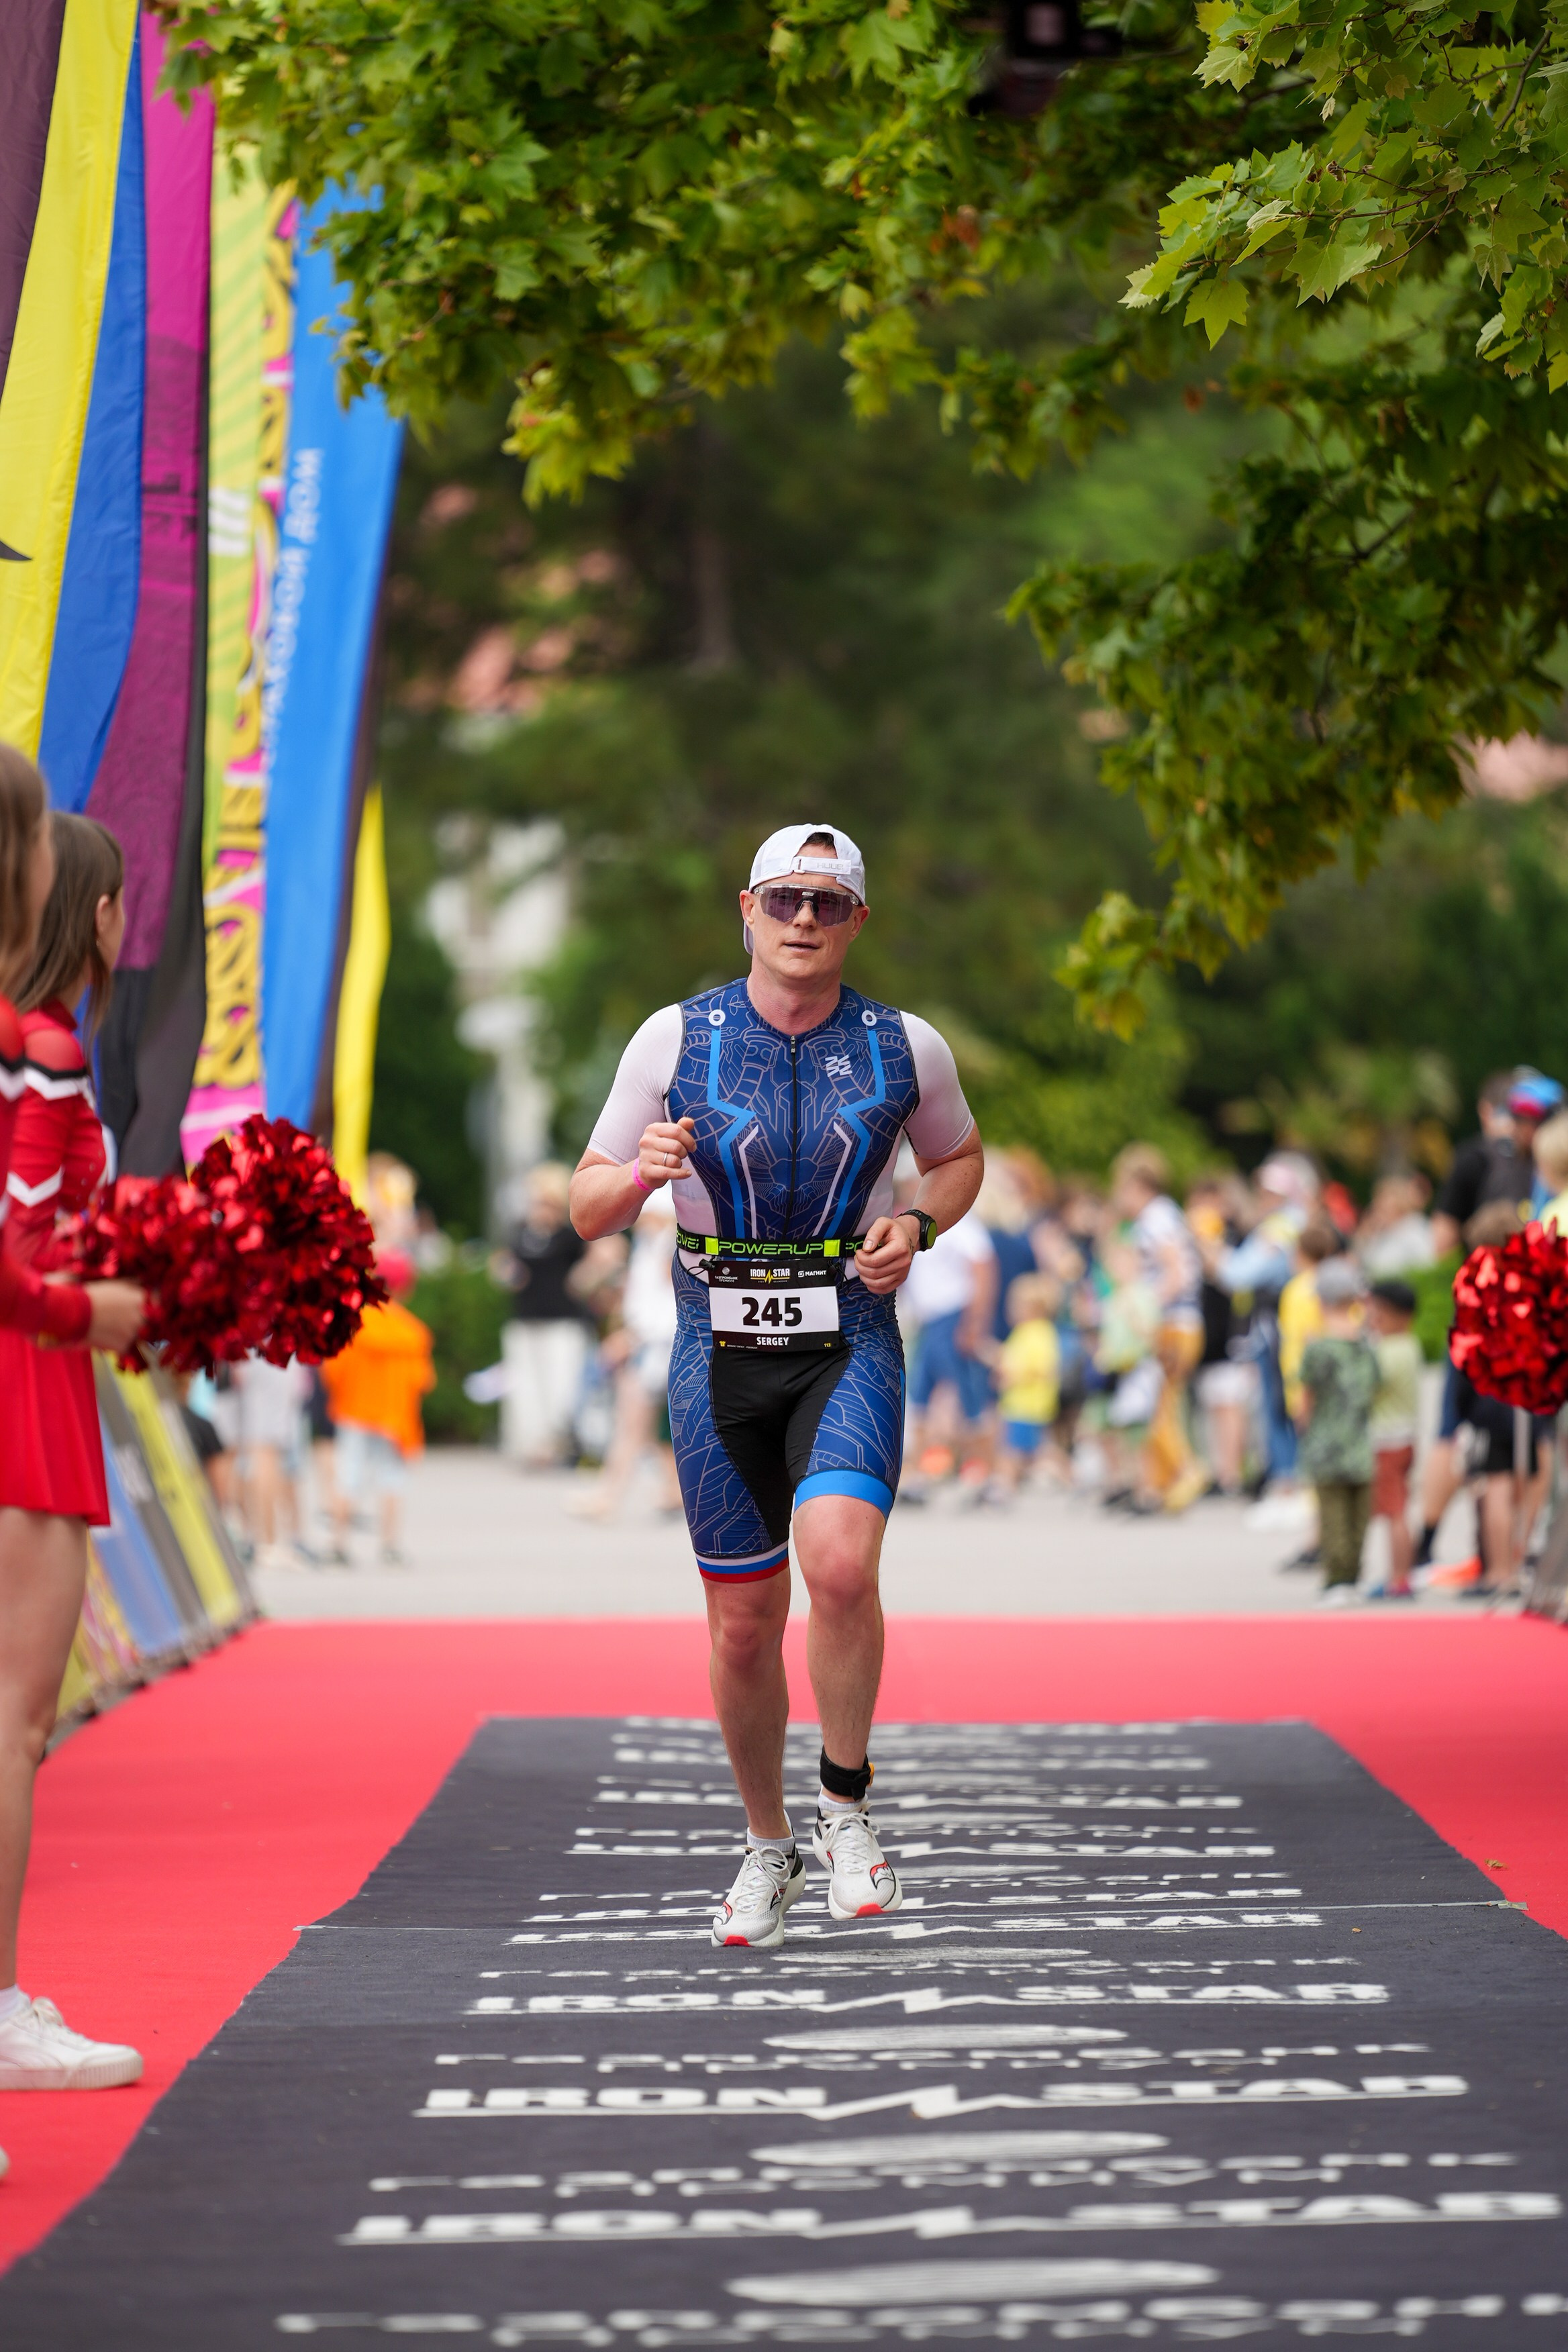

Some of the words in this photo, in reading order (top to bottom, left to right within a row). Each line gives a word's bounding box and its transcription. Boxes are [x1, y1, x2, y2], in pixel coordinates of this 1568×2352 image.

[677, 1230, 699, 1249] OWE
[719, 1241, 824, 1255] POWERUP
[750, 1269, 766, 1277] IRON
[773, 1268, 790, 1277] STAR
[742, 1297, 802, 1327] 245
[756, 1336, 789, 1346] SERGEY
[988, 1842, 1275, 1856] STAR
[988, 1888, 1302, 1903] STAR
[991, 1912, 1324, 1927] STAR
[476, 1989, 826, 2010] IRON
[1016, 1983, 1391, 2000] STAR
[425, 2087, 827, 2109] IRON
[1041, 2075, 1470, 2102] STAR
[352, 2208, 823, 2237] IRON
[1069, 2192, 1563, 2224] STAR
